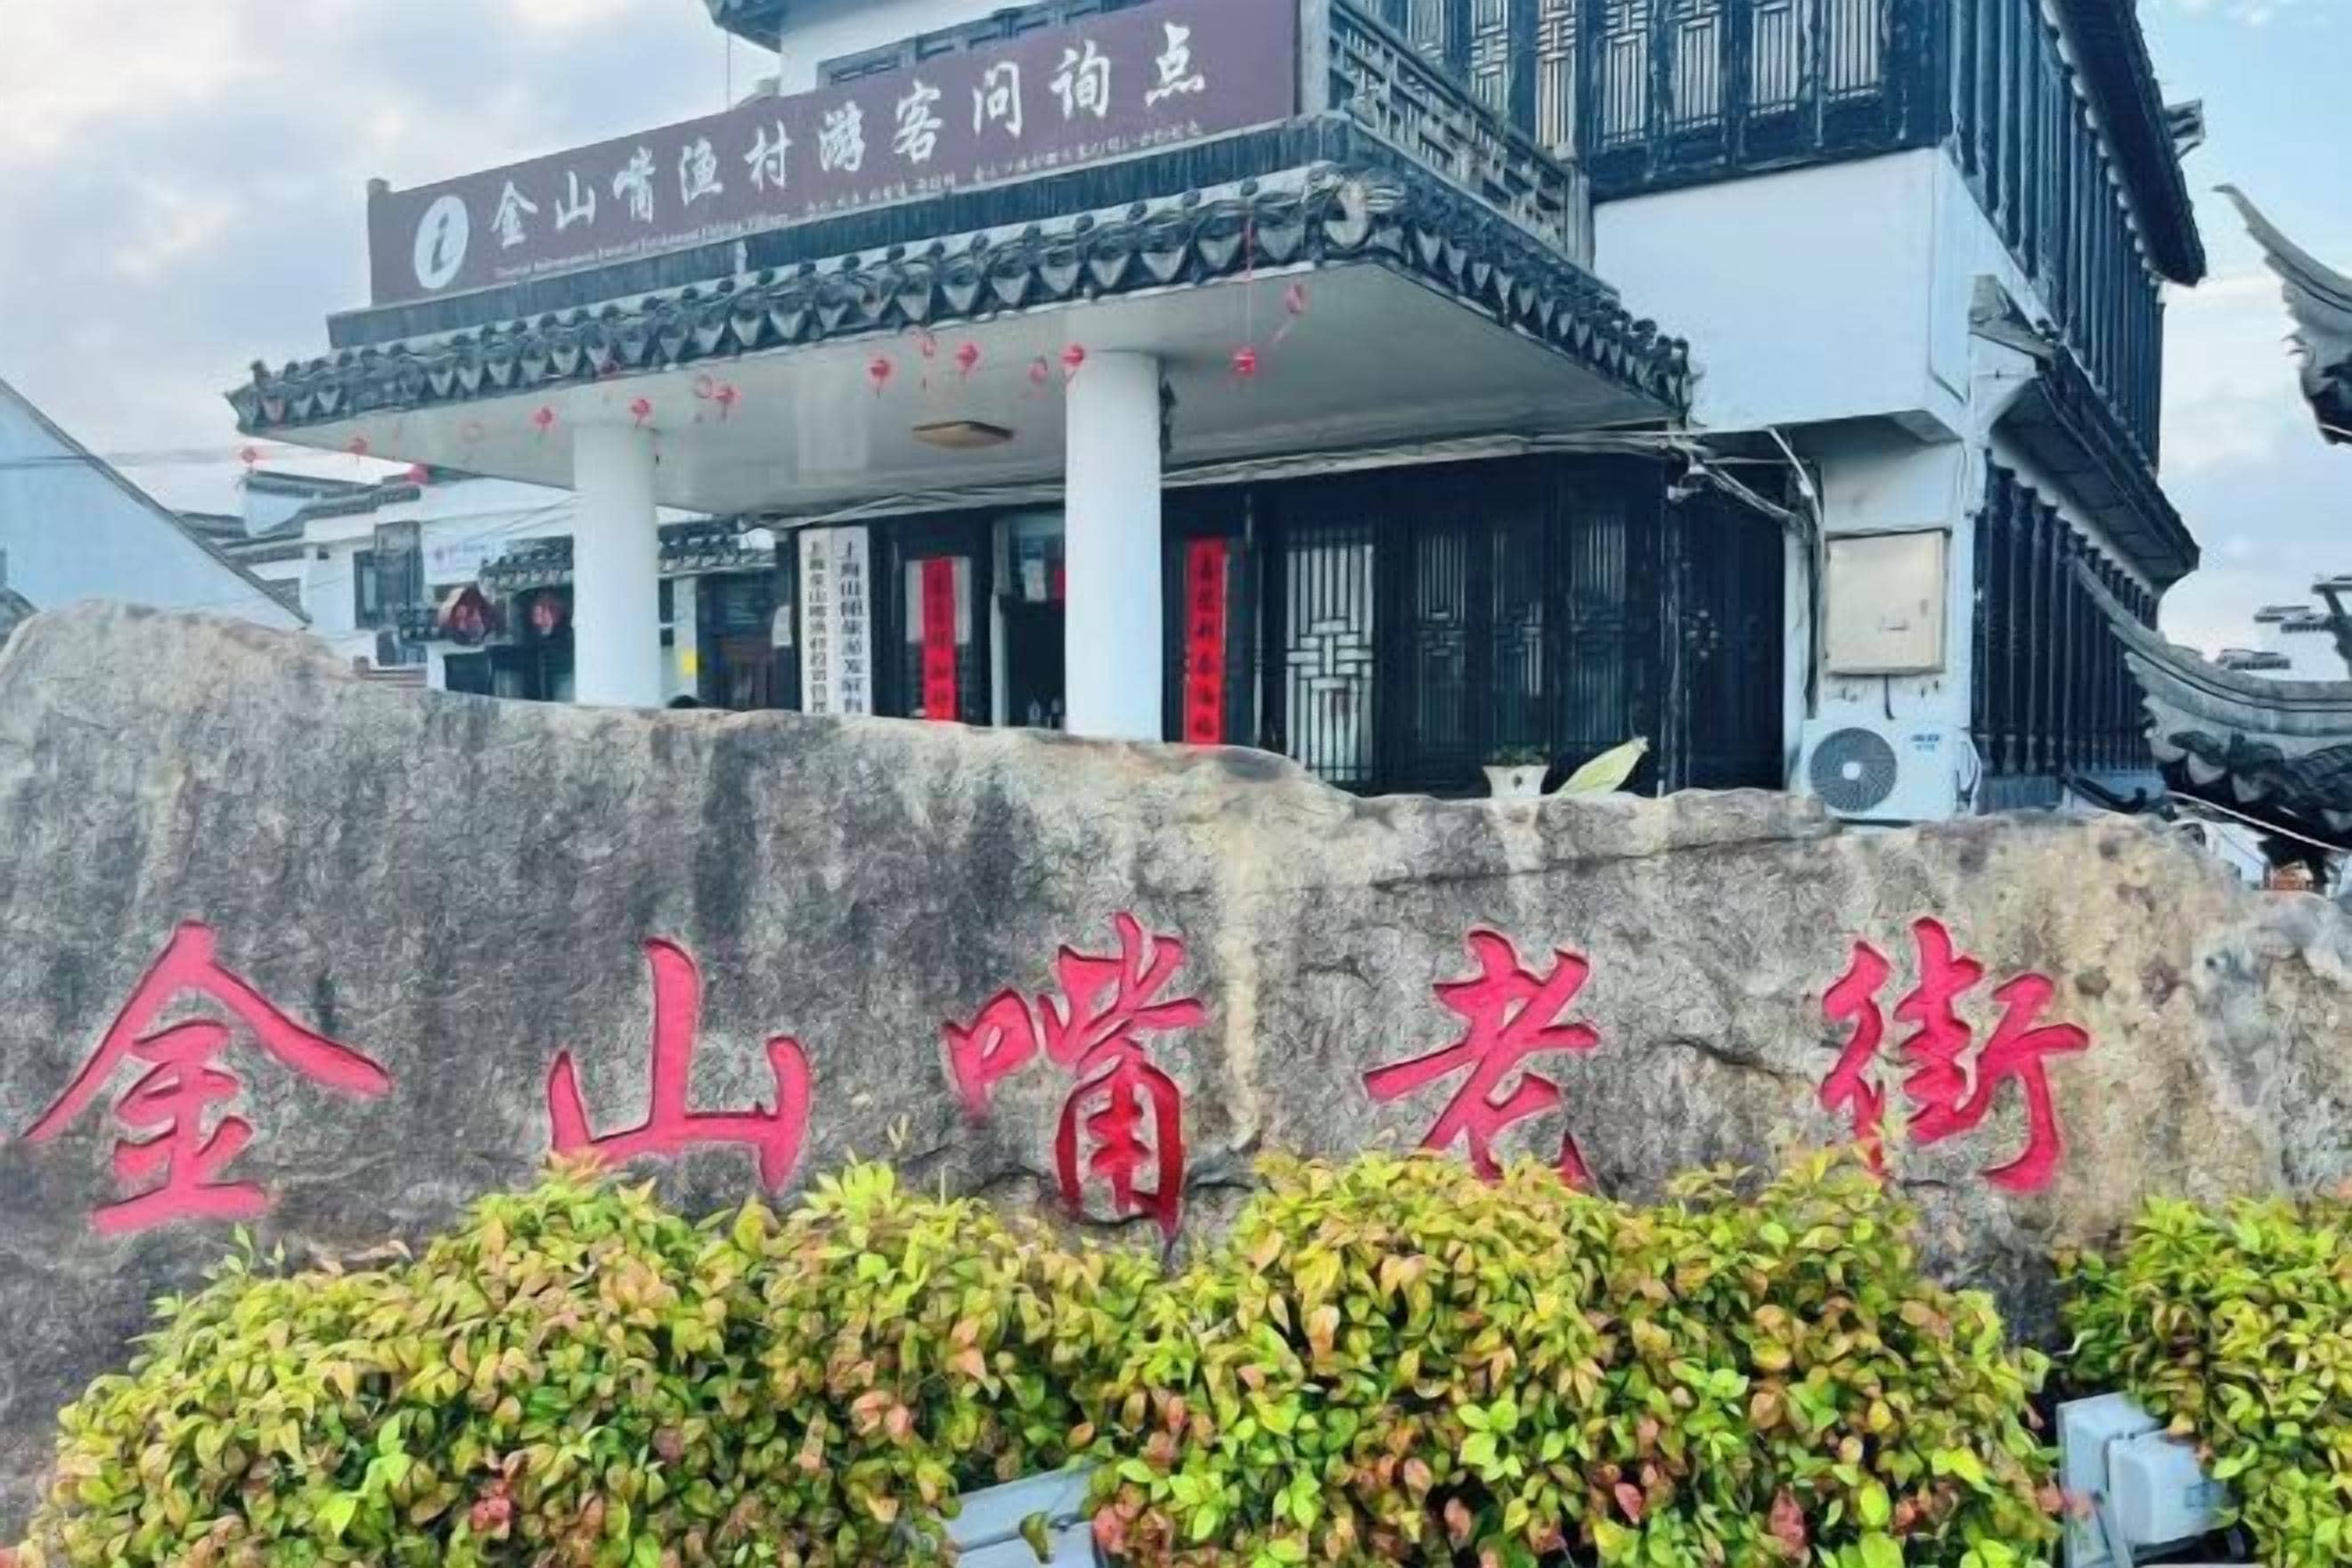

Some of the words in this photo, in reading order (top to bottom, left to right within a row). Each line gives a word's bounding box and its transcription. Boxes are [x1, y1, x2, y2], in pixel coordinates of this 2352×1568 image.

[20, 911, 2090, 1239] 金山嘴老街
